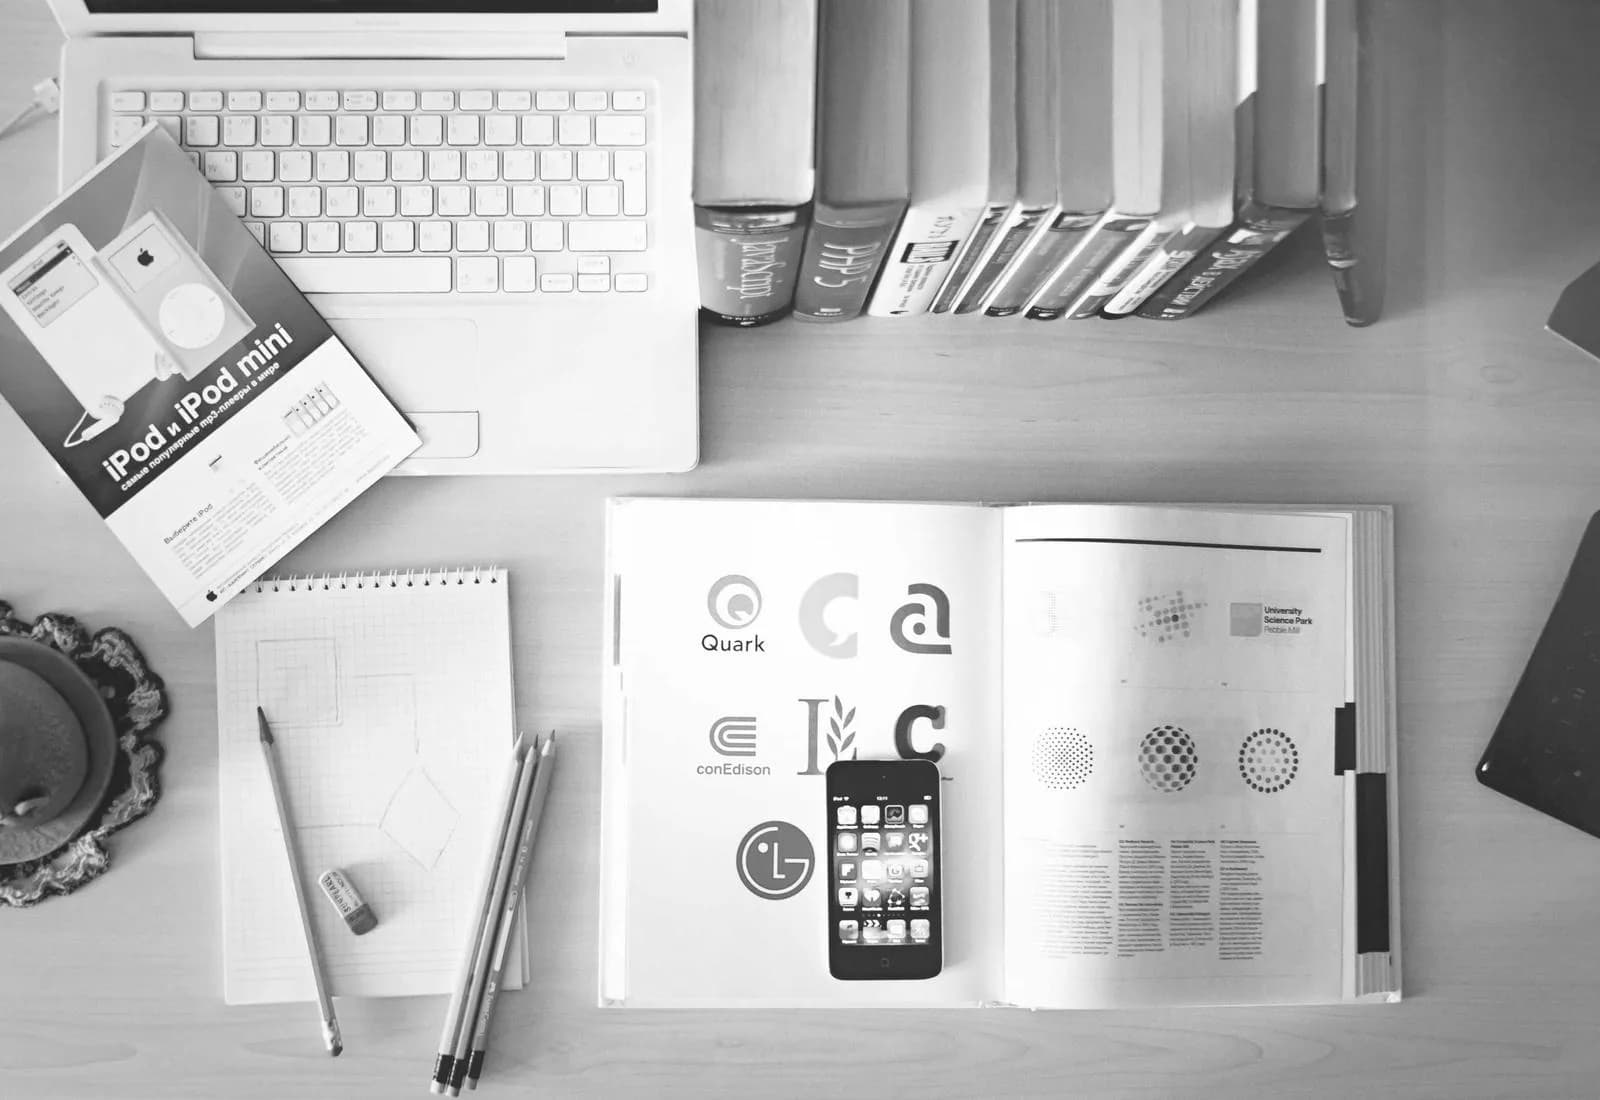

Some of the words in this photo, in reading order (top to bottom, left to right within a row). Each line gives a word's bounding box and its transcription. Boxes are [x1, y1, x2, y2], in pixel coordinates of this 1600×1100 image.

[725, 236, 783, 301] JavaScript
[821, 241, 886, 275] PHP
[235, 322, 294, 377] mini
[174, 367, 236, 426] iPod
[120, 467, 150, 492] самые
[149, 424, 201, 469] популярные
[200, 387, 251, 429] mp3-плееры
[256, 361, 281, 385] мире
[167, 422, 182, 438] и
[102, 424, 166, 483] iPod
[163, 514, 198, 545] Выберите
[1264, 606, 1303, 616] University
[701, 634, 766, 653] Quark
[696, 763, 771, 776] conEdison
